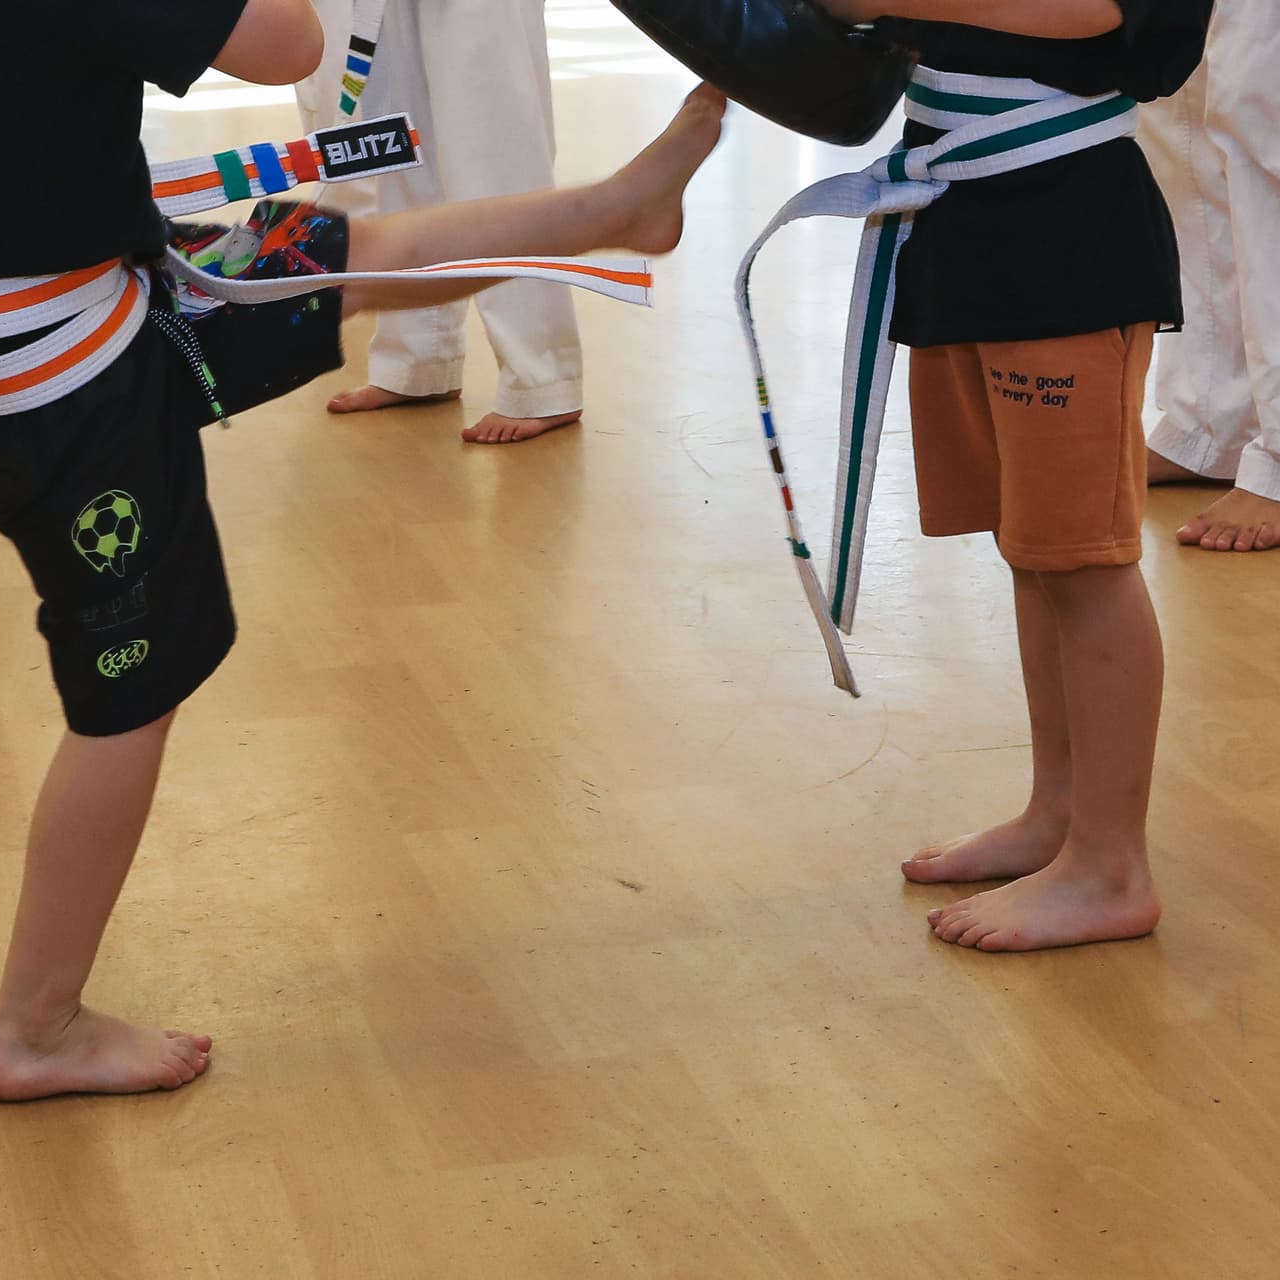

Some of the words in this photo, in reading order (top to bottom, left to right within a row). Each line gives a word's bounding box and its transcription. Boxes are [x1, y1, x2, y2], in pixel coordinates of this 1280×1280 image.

[324, 130, 403, 166] BLITZ
[1008, 370, 1029, 386] the
[1035, 374, 1075, 391] good
[1002, 387, 1034, 407] every
[1041, 390, 1069, 409] day
